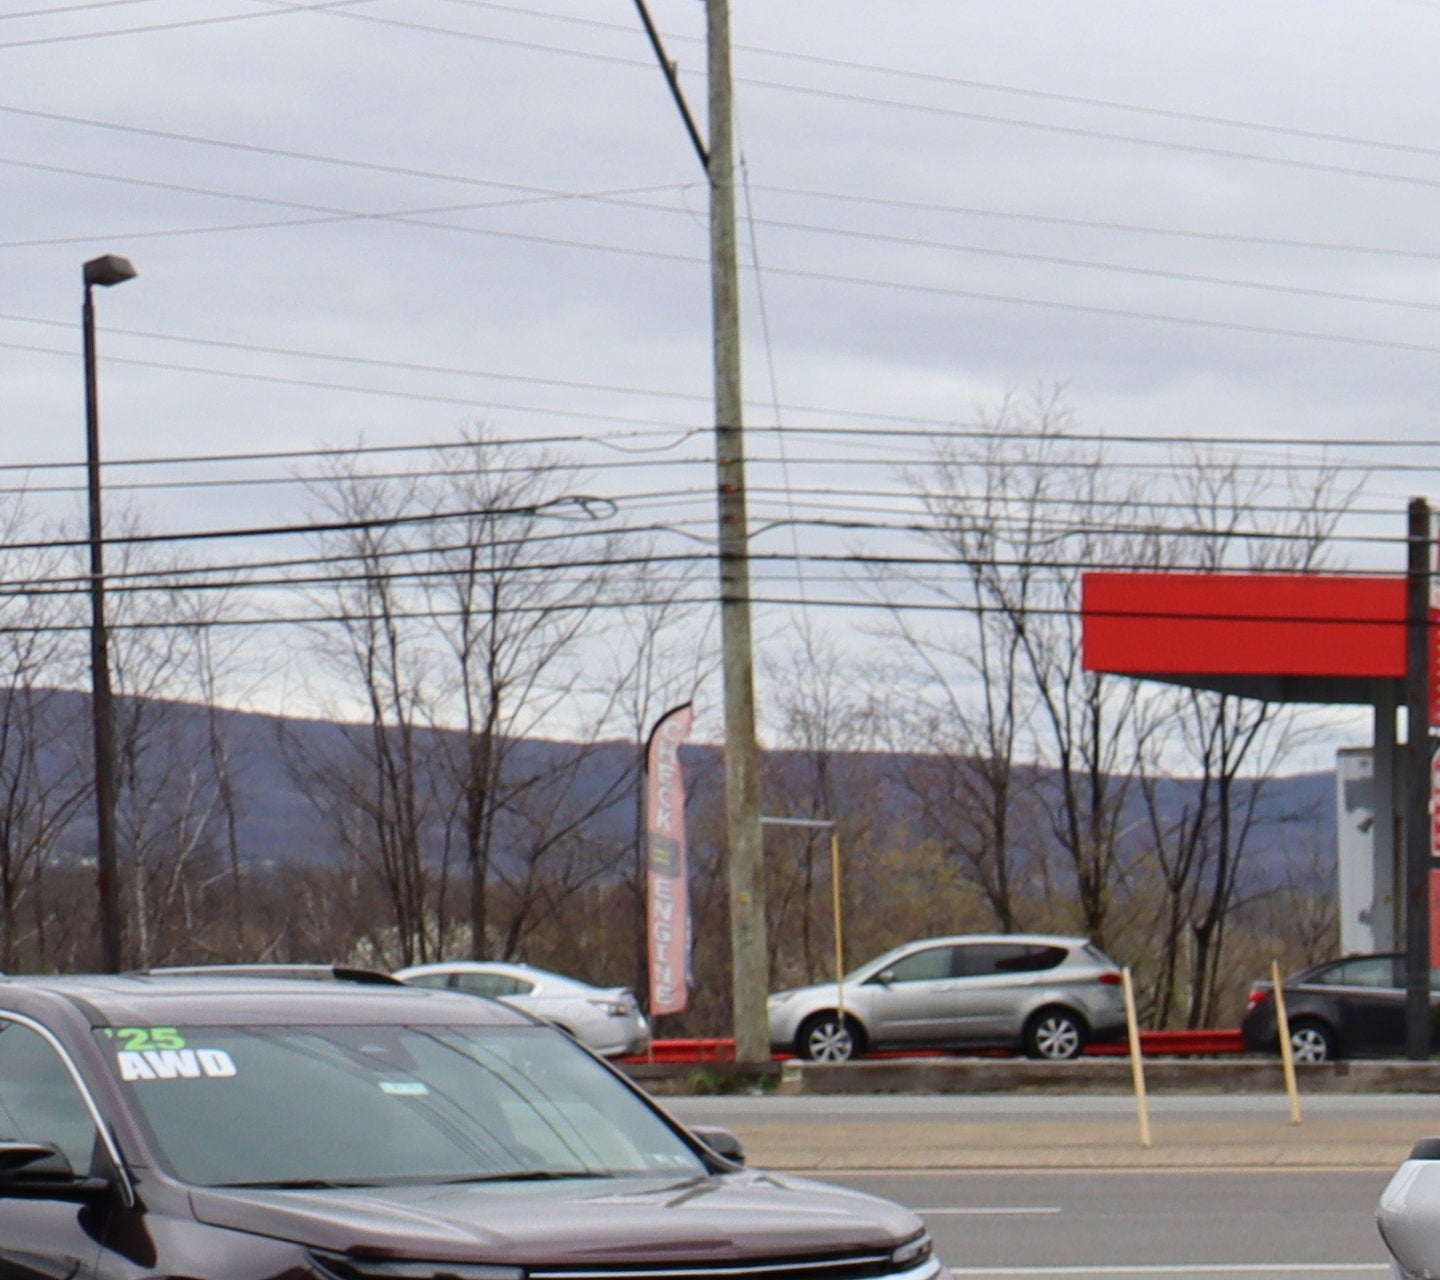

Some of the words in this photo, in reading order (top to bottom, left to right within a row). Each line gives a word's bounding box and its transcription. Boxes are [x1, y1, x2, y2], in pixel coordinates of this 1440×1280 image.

[651, 879, 674, 1006] ENGINE
[103, 1027, 186, 1050] '25
[116, 1049, 238, 1081] AWD
